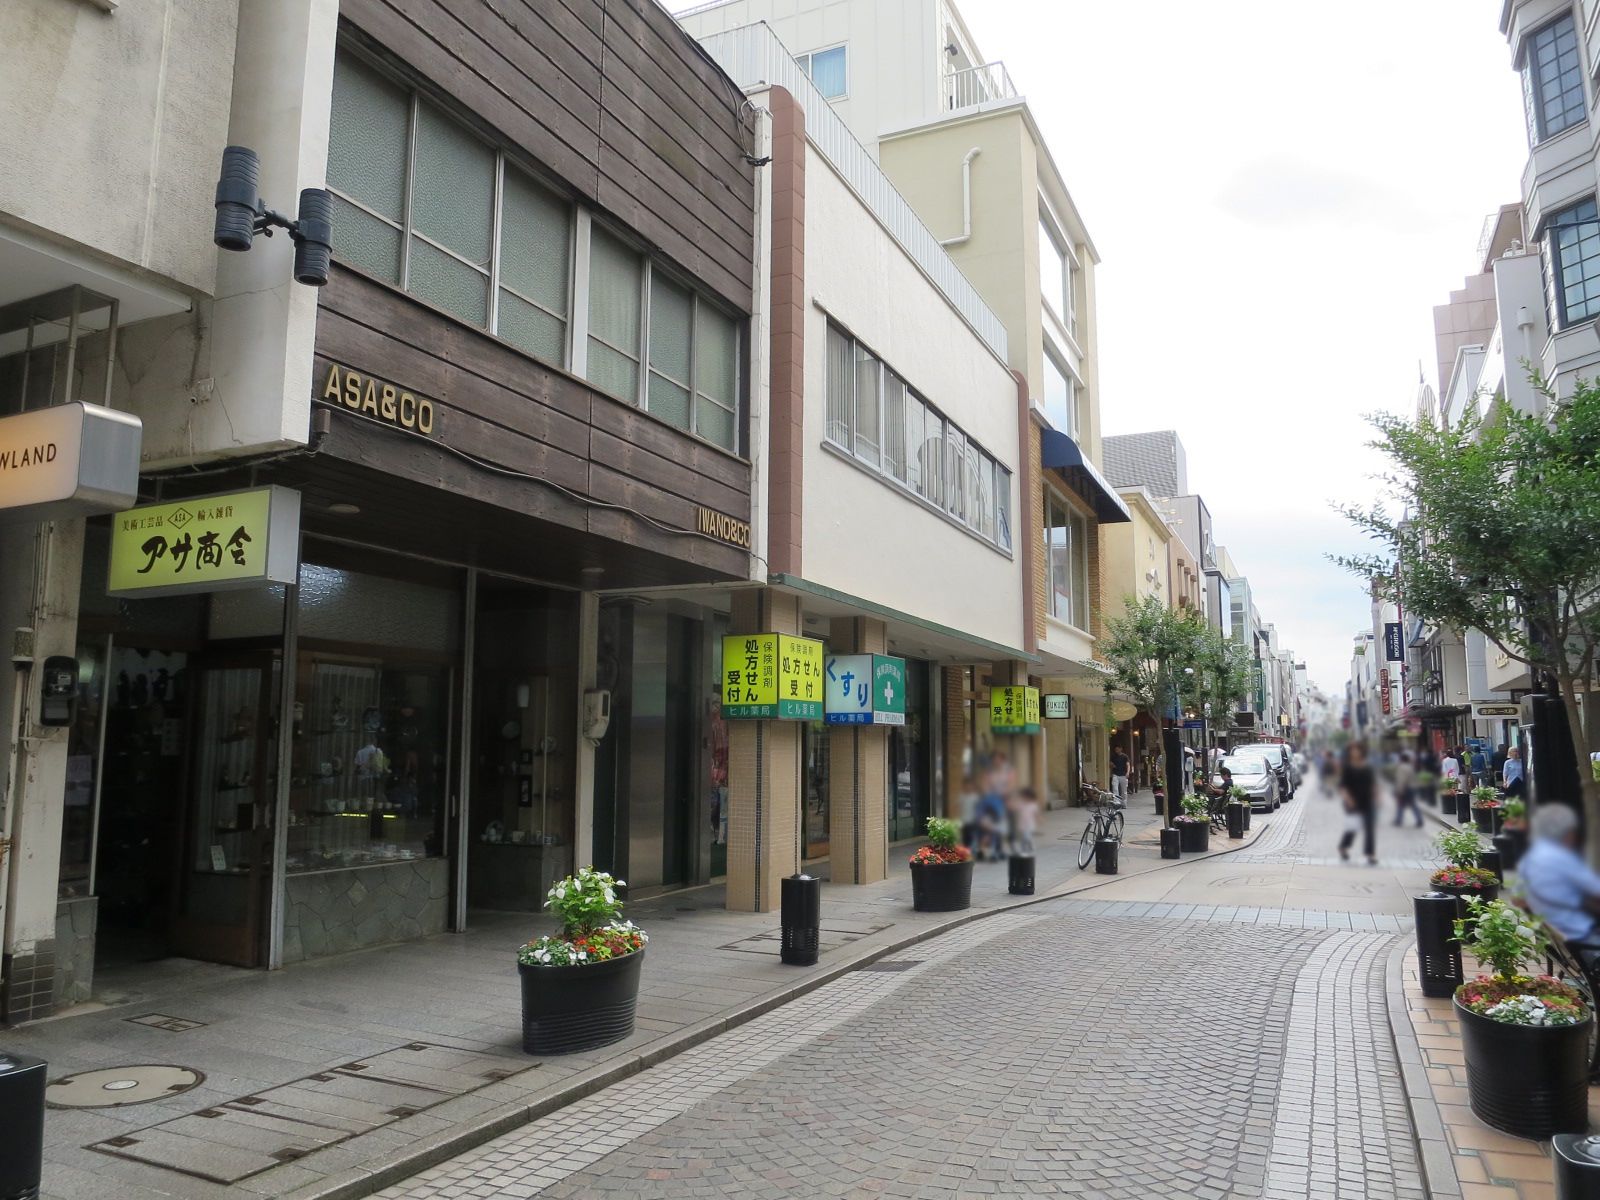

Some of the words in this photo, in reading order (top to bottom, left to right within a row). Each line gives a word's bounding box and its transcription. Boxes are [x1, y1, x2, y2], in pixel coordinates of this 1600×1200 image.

[324, 364, 433, 434] ASA&CO
[122, 516, 163, 531] 美術工芸品
[174, 513, 186, 522] ASA
[698, 507, 751, 547] IWANO&CO
[137, 525, 252, 573] アサ商会
[745, 639, 759, 702] 処方せん
[763, 642, 773, 688] 保険調剤
[783, 657, 820, 678] 処方せん
[727, 670, 741, 702] 受付
[790, 680, 814, 698] 受付
[826, 658, 868, 707] くすり
[729, 706, 770, 716] ヒル薬局
[787, 703, 815, 717] ヒル薬局
[830, 713, 865, 722] ヒル薬局
